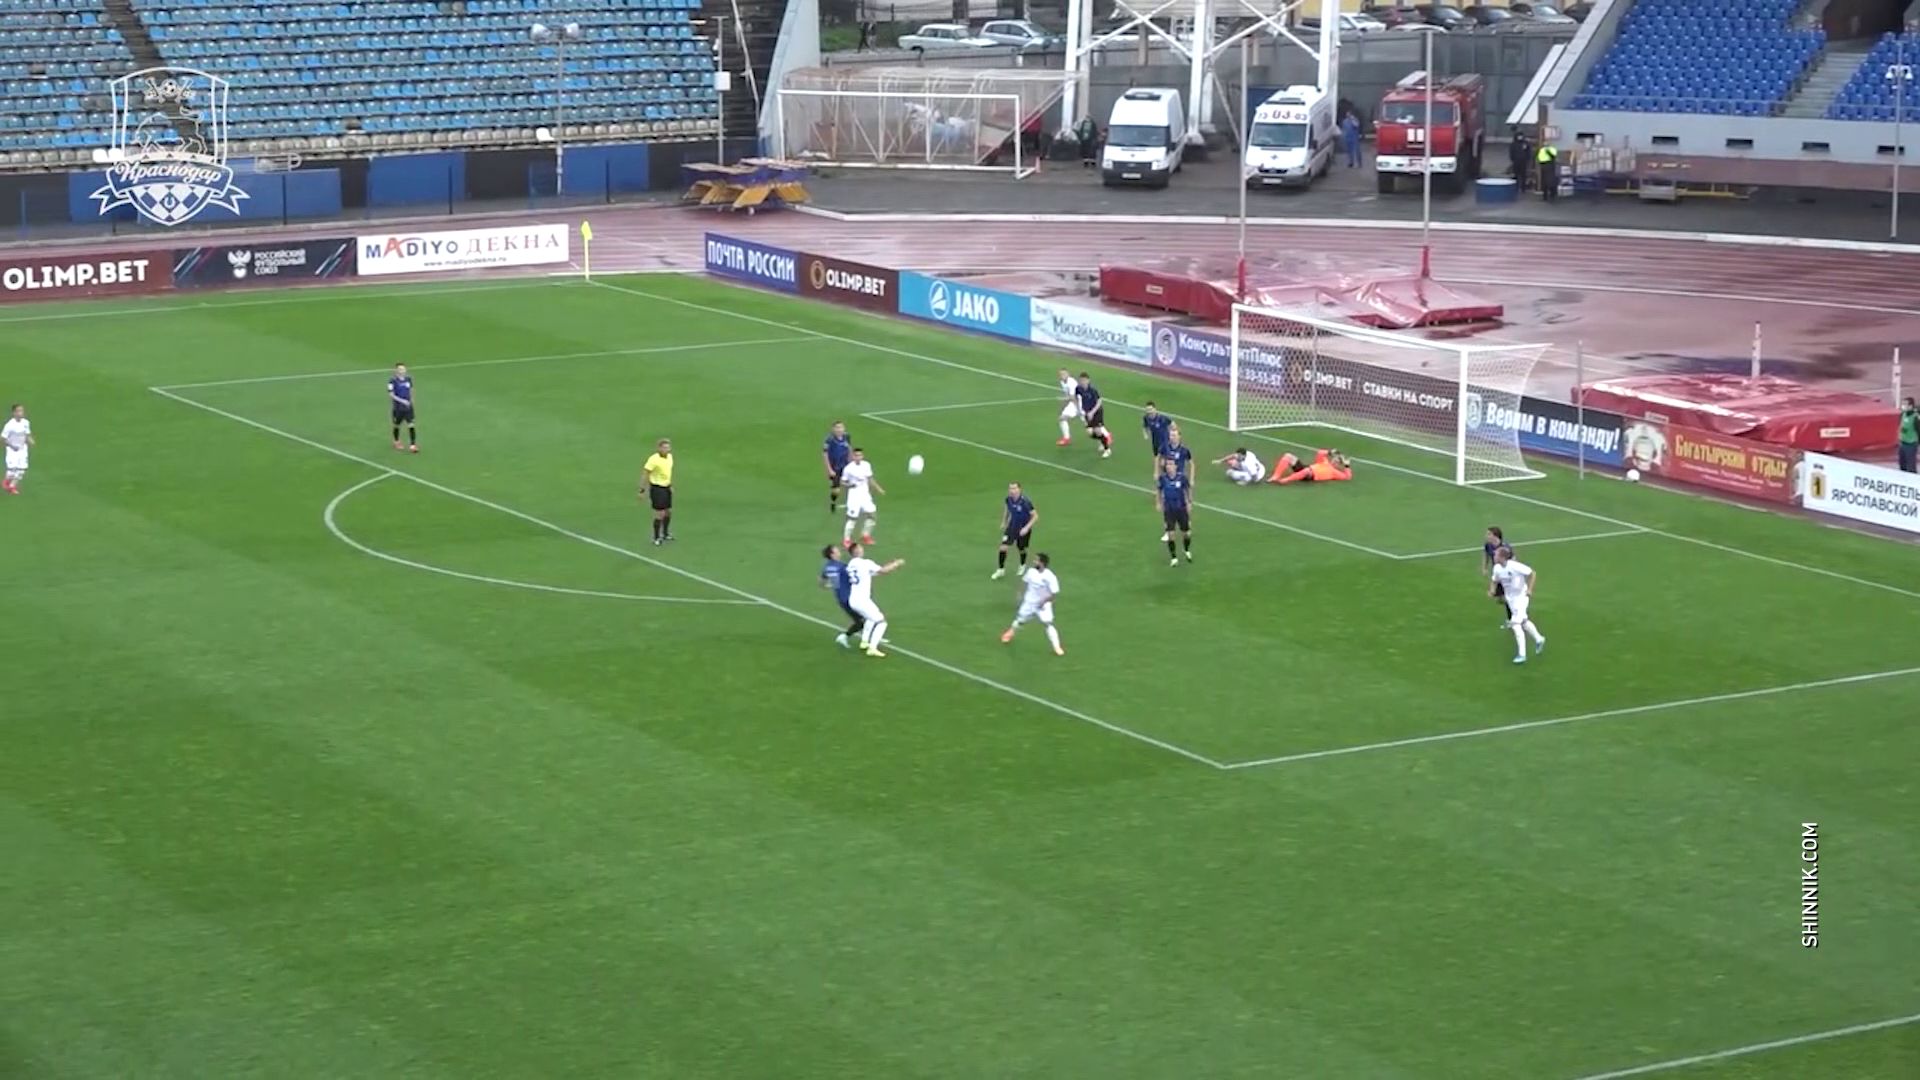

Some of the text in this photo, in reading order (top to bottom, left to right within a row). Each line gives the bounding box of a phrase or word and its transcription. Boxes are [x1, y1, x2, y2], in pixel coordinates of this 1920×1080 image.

[366, 236, 459, 259] MADIYO
[466, 233, 561, 256] ДЕКНА
[3, 259, 149, 290] OLIMP.BET
[707, 240, 796, 282] ПОЧТА РОССИИ
[826, 268, 887, 297] OLIMP.BET
[952, 290, 1000, 324] JAKO
[1053, 315, 1129, 346] Михайловская
[1362, 381, 1454, 411] СТАВКИ НА СПОРТ
[1486, 402, 1534, 433] Верим
[1831, 488, 1919, 518] ЯРОСЛАВСКОЙ
